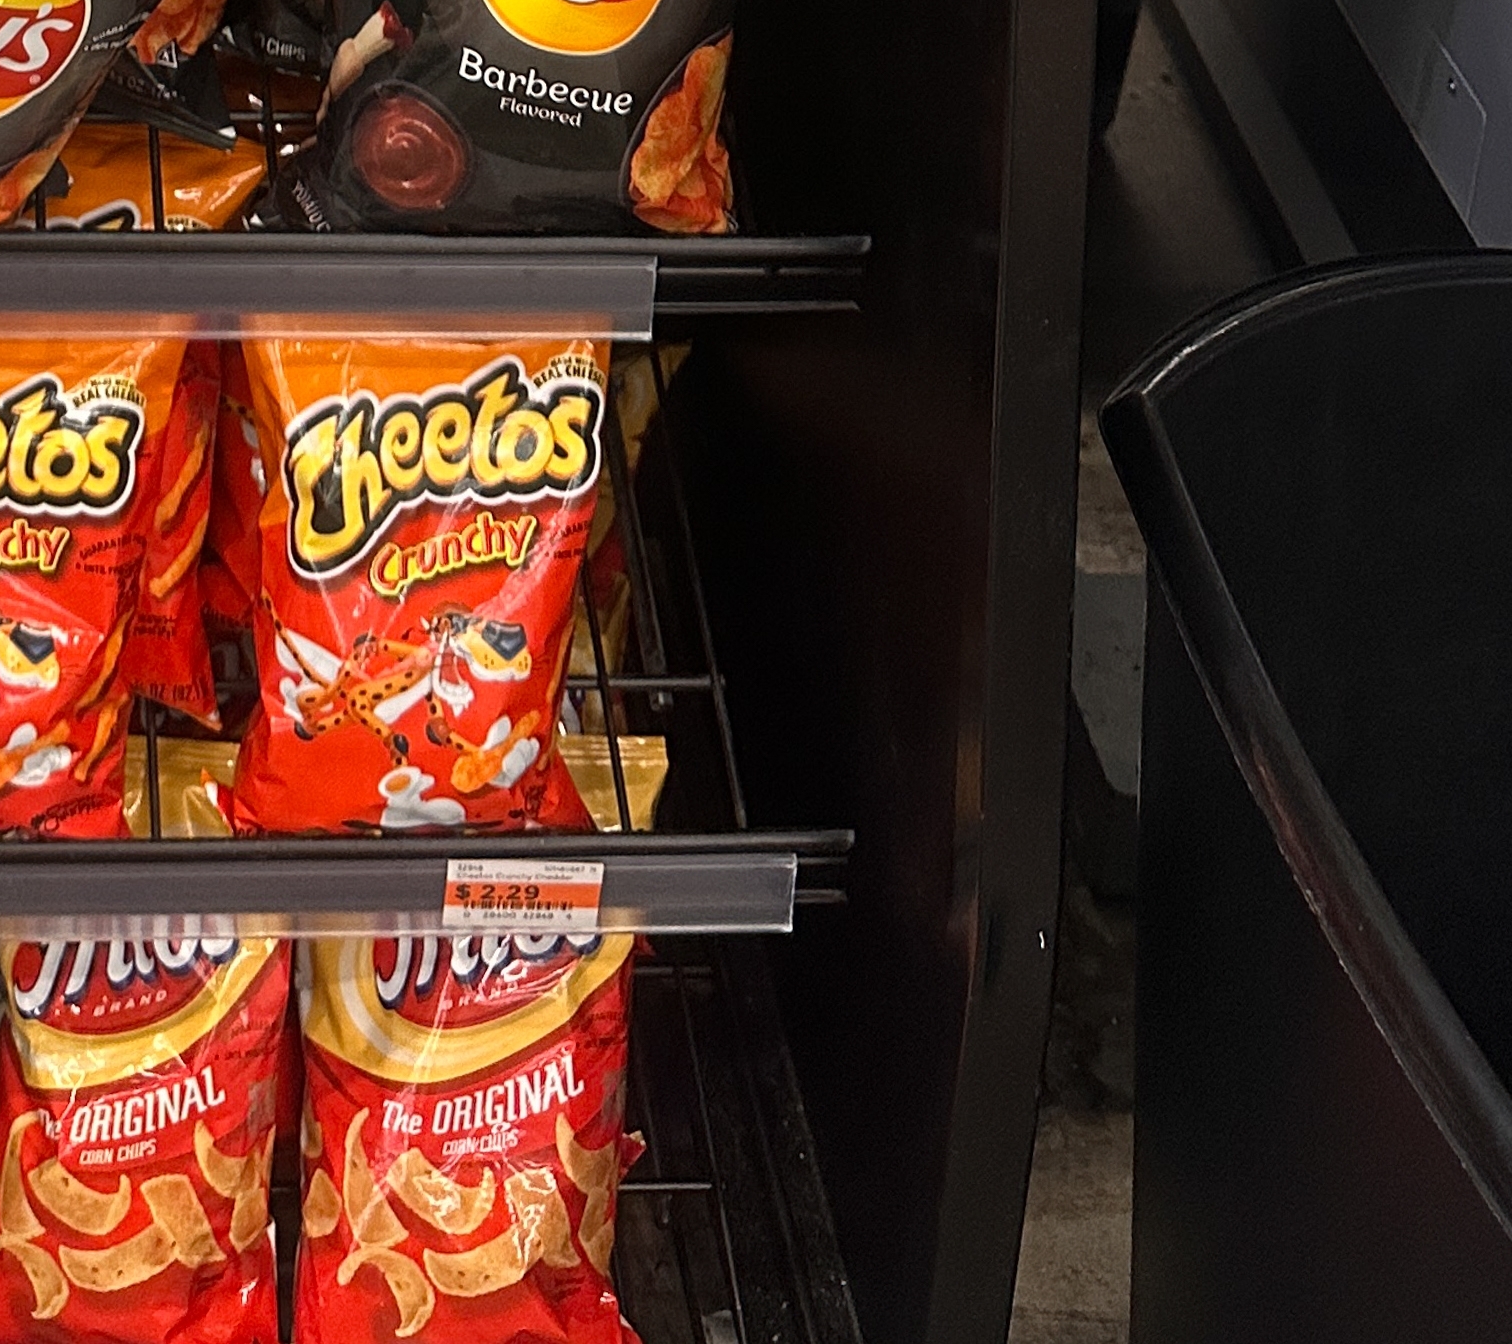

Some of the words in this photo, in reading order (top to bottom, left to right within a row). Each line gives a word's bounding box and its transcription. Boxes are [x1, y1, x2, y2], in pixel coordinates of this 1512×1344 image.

[458, 47, 633, 115] Barbecue
[499, 96, 581, 127] Flavored
[290, 370, 592, 562] Cheetos
[371, 512, 536, 596] Crunchy
[481, 885, 540, 900] 2.29
[69, 1066, 226, 1144] ORIGINAL
[383, 1100, 422, 1134] The
[432, 1054, 584, 1134] ORIGINAL
[79, 1148, 113, 1165] CORN
[117, 1139, 156, 1162] CHIPS
